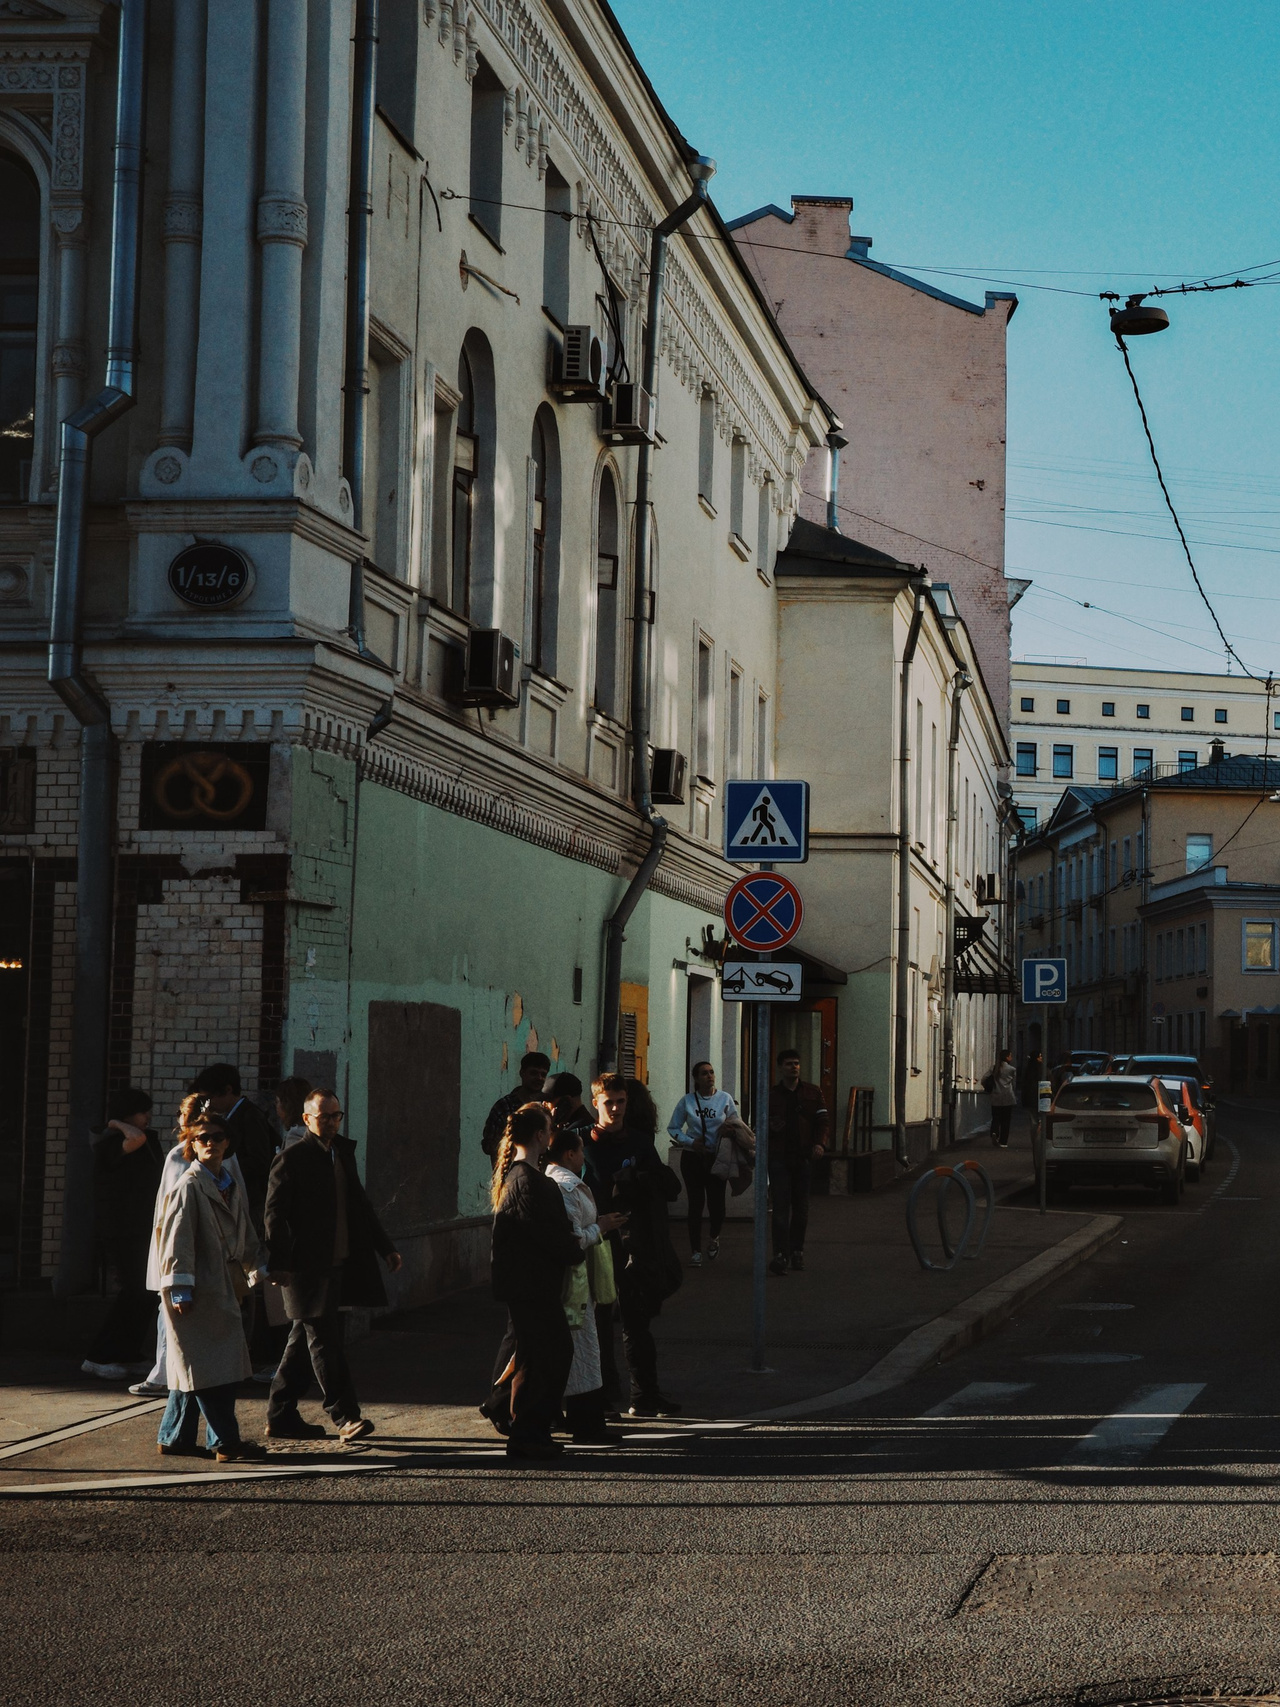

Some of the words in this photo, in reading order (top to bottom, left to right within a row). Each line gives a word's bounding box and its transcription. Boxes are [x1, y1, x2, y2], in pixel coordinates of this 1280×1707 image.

[177, 565, 240, 588] 1/13/6
[184, 589, 228, 603] СТРОЕНИЕ
[1035, 964, 1059, 998] P
